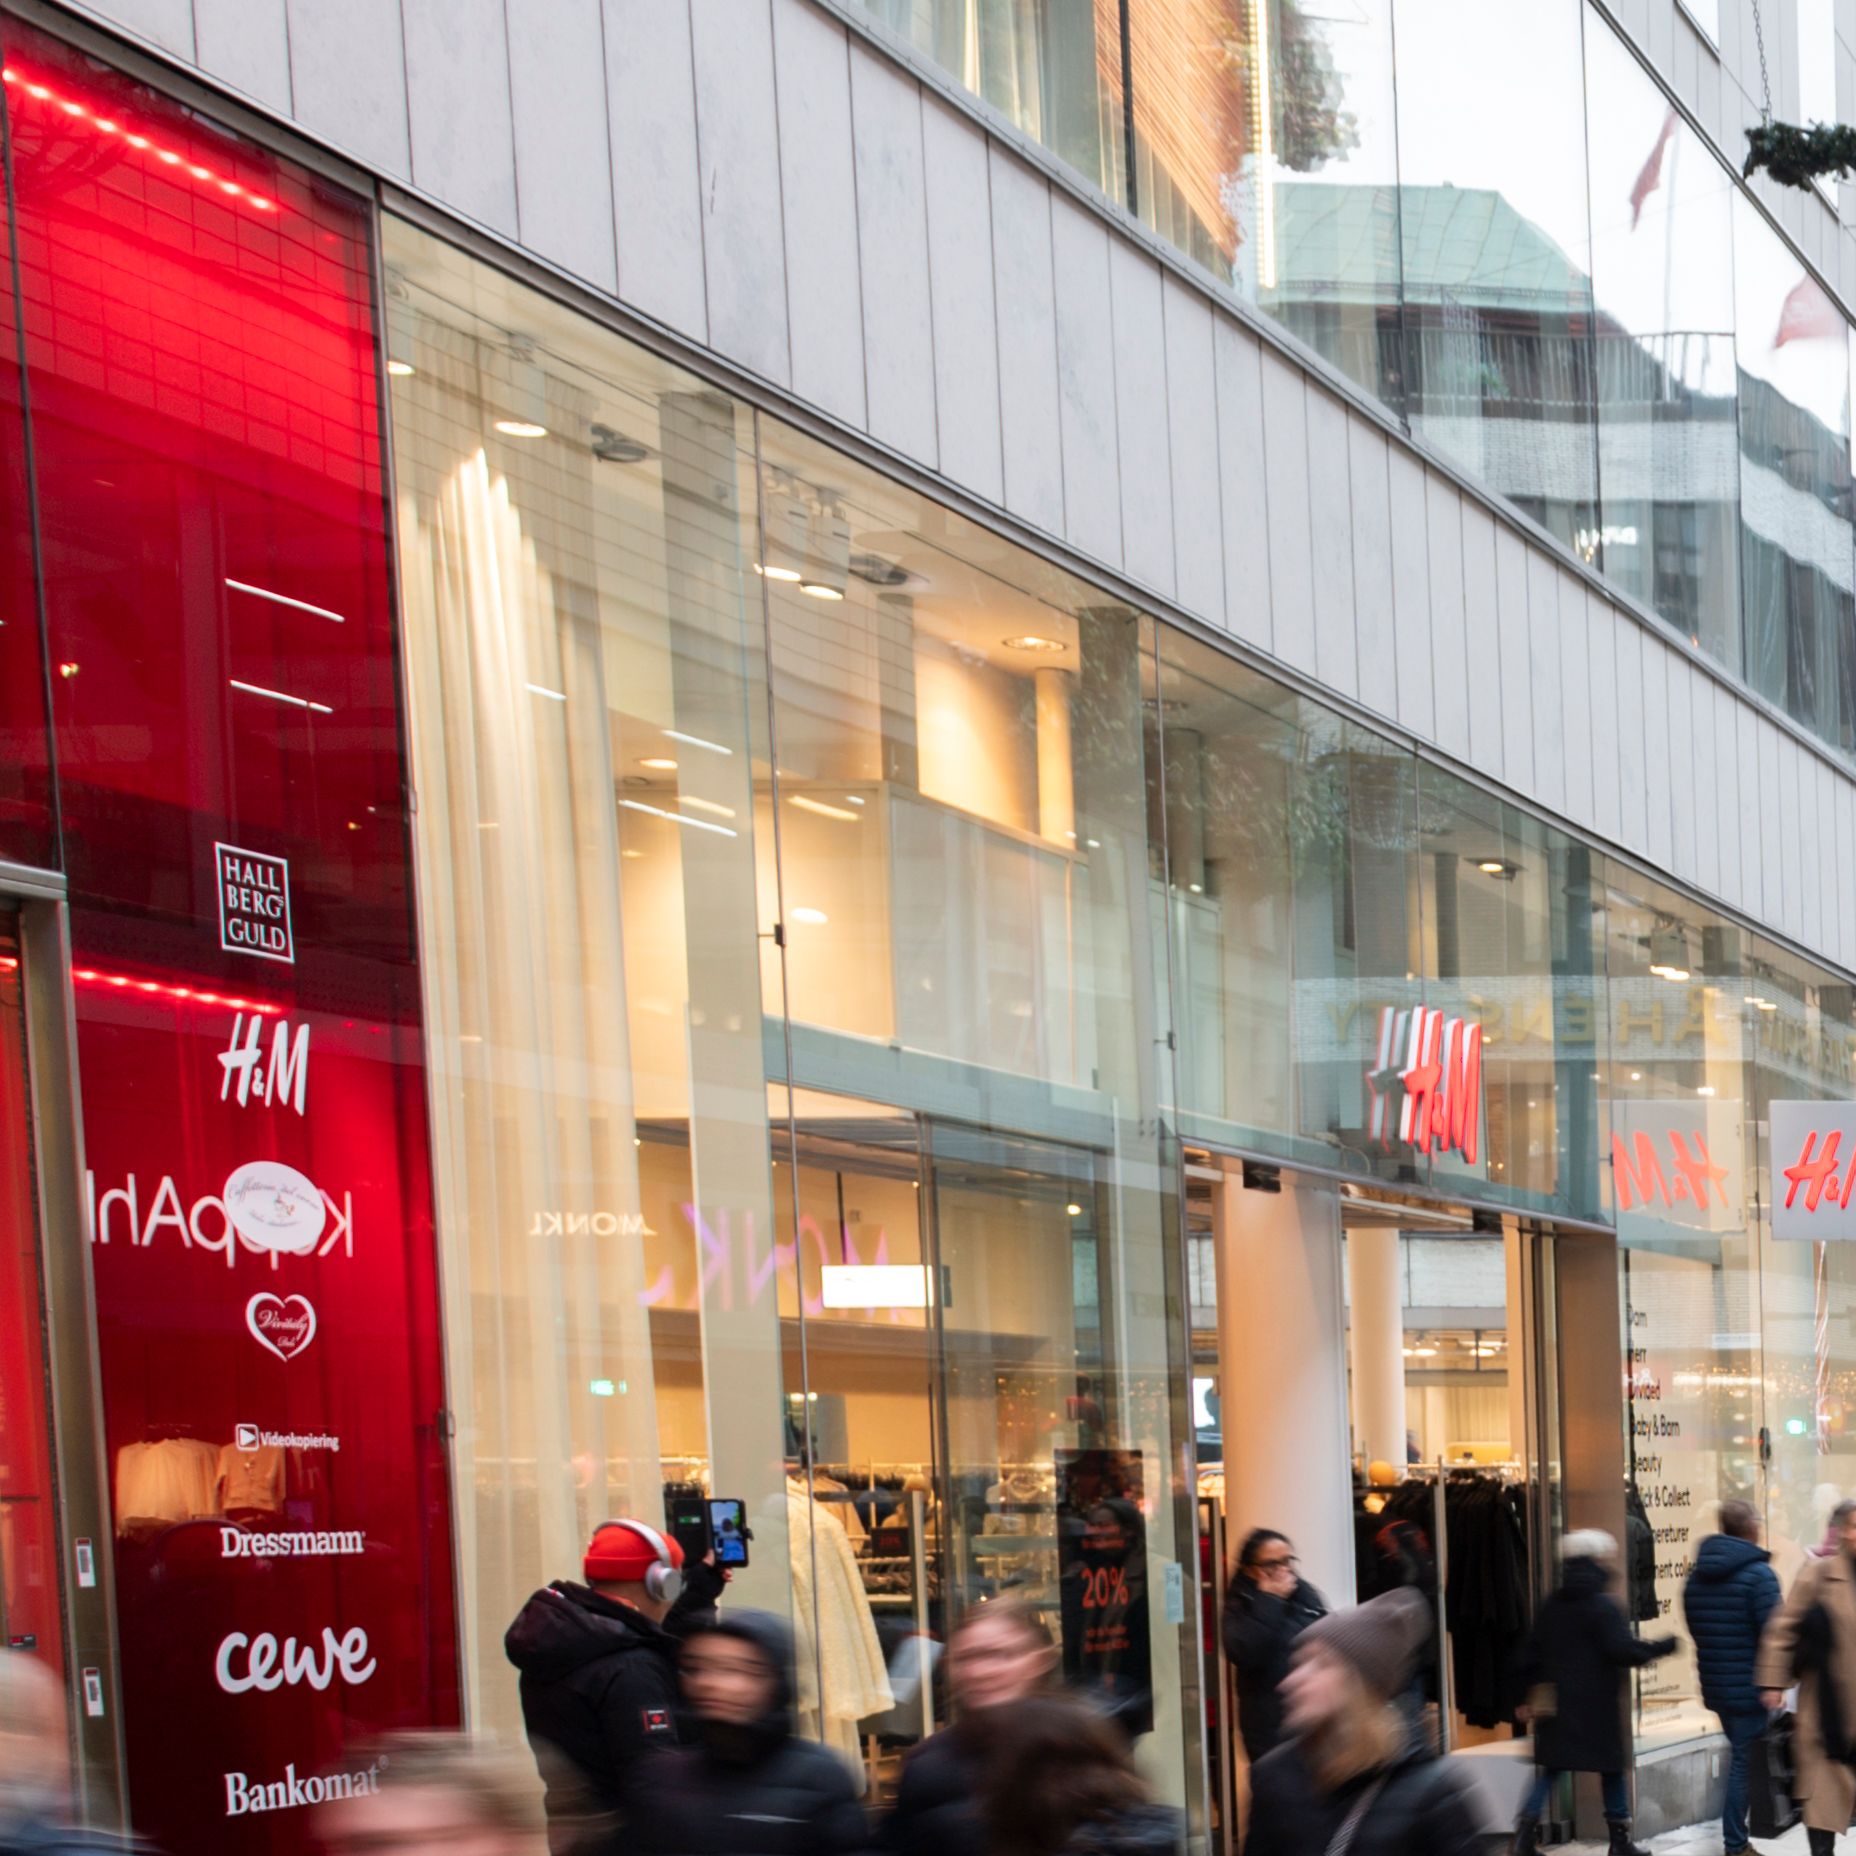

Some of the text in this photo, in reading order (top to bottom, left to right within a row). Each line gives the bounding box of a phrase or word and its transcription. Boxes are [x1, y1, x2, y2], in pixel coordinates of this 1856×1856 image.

[224, 856, 280, 891] HALL
[229, 918, 286, 951] GULD
[218, 1011, 310, 1117] H&M
[260, 1431, 341, 1453] Videokopiering
[1662, 1485, 1691, 1507] Collect
[220, 1527, 365, 1558] Dressmann
[1081, 1567, 1129, 1609] 20%
[216, 1625, 377, 1695] cewe
